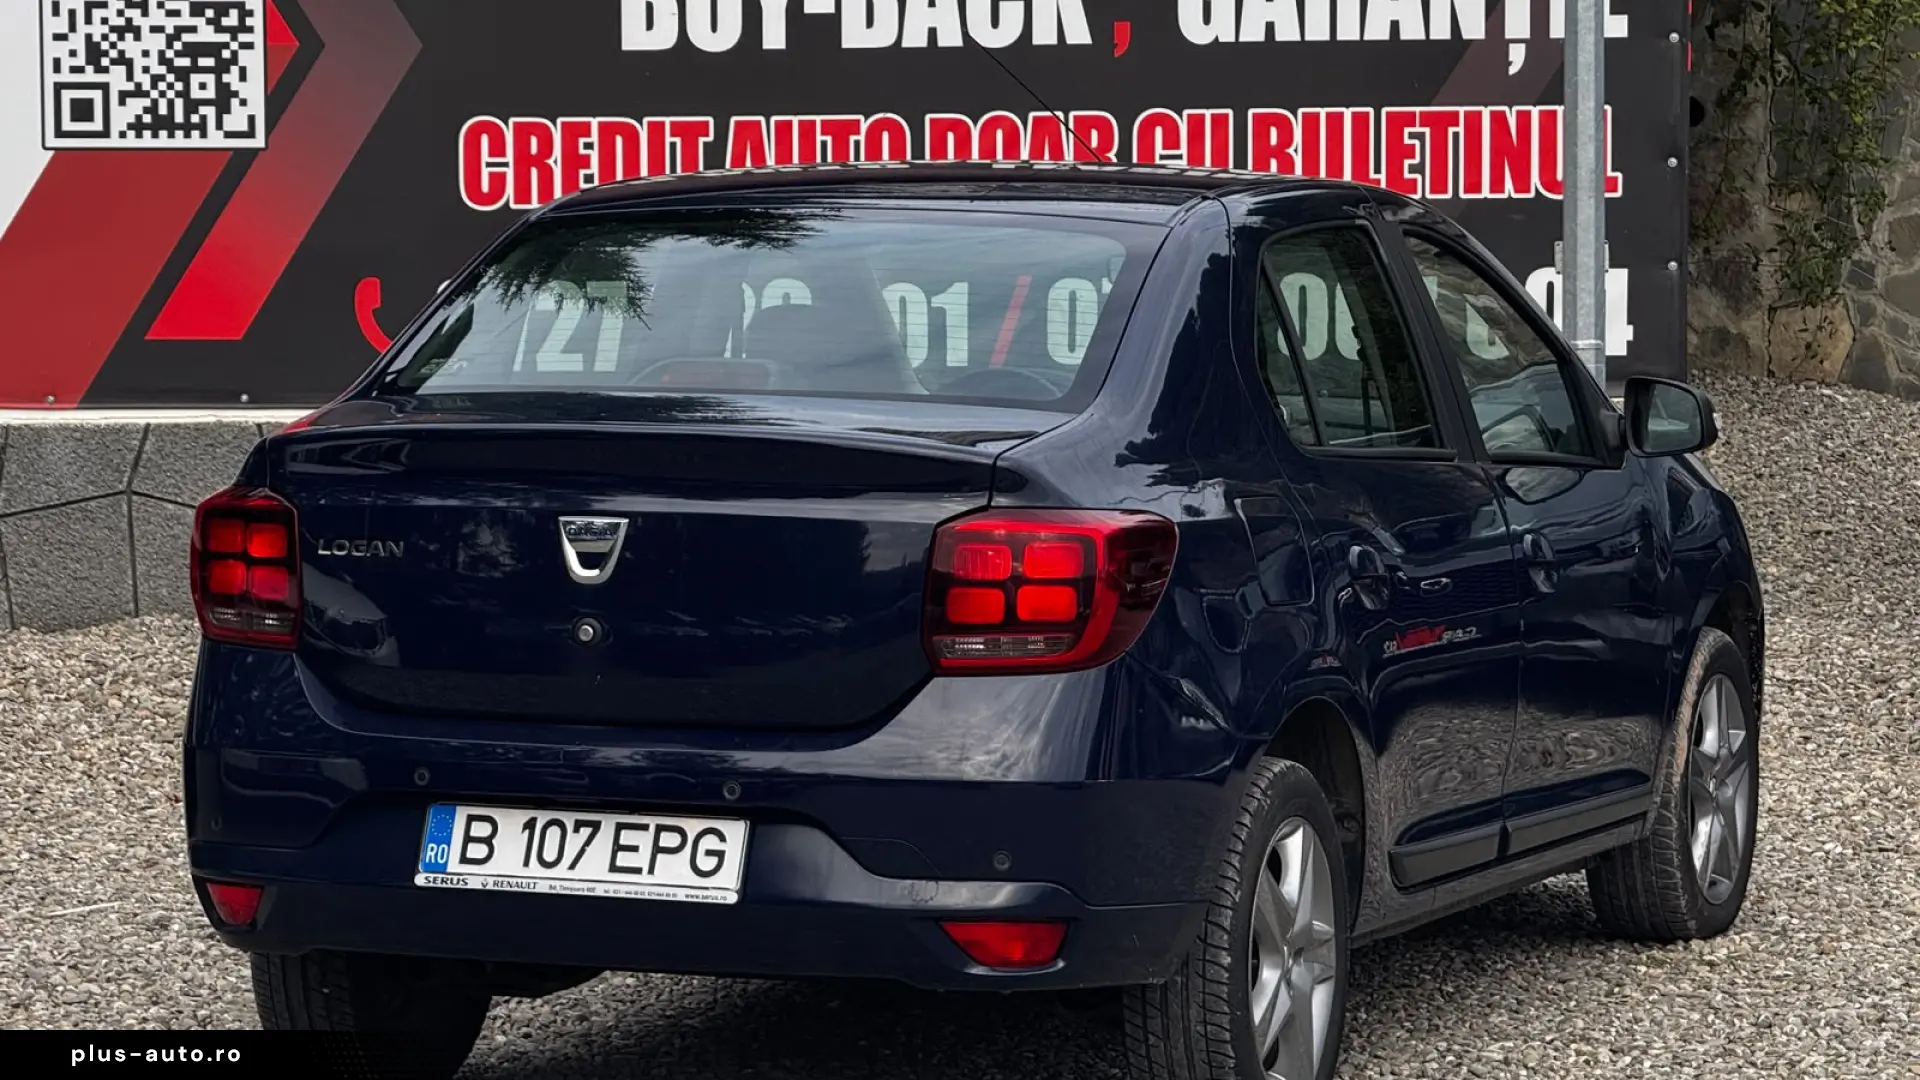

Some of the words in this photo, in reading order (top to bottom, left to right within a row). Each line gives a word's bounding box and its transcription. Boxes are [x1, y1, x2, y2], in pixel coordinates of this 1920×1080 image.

[458, 115, 714, 210] CREDIT
[317, 539, 405, 558] LOGAN
[425, 843, 448, 865] RO
[458, 813, 500, 866] B
[520, 815, 603, 870] 107
[607, 821, 728, 879] EPG
[423, 875, 470, 888] SERUS
[491, 878, 539, 891] RENAULT
